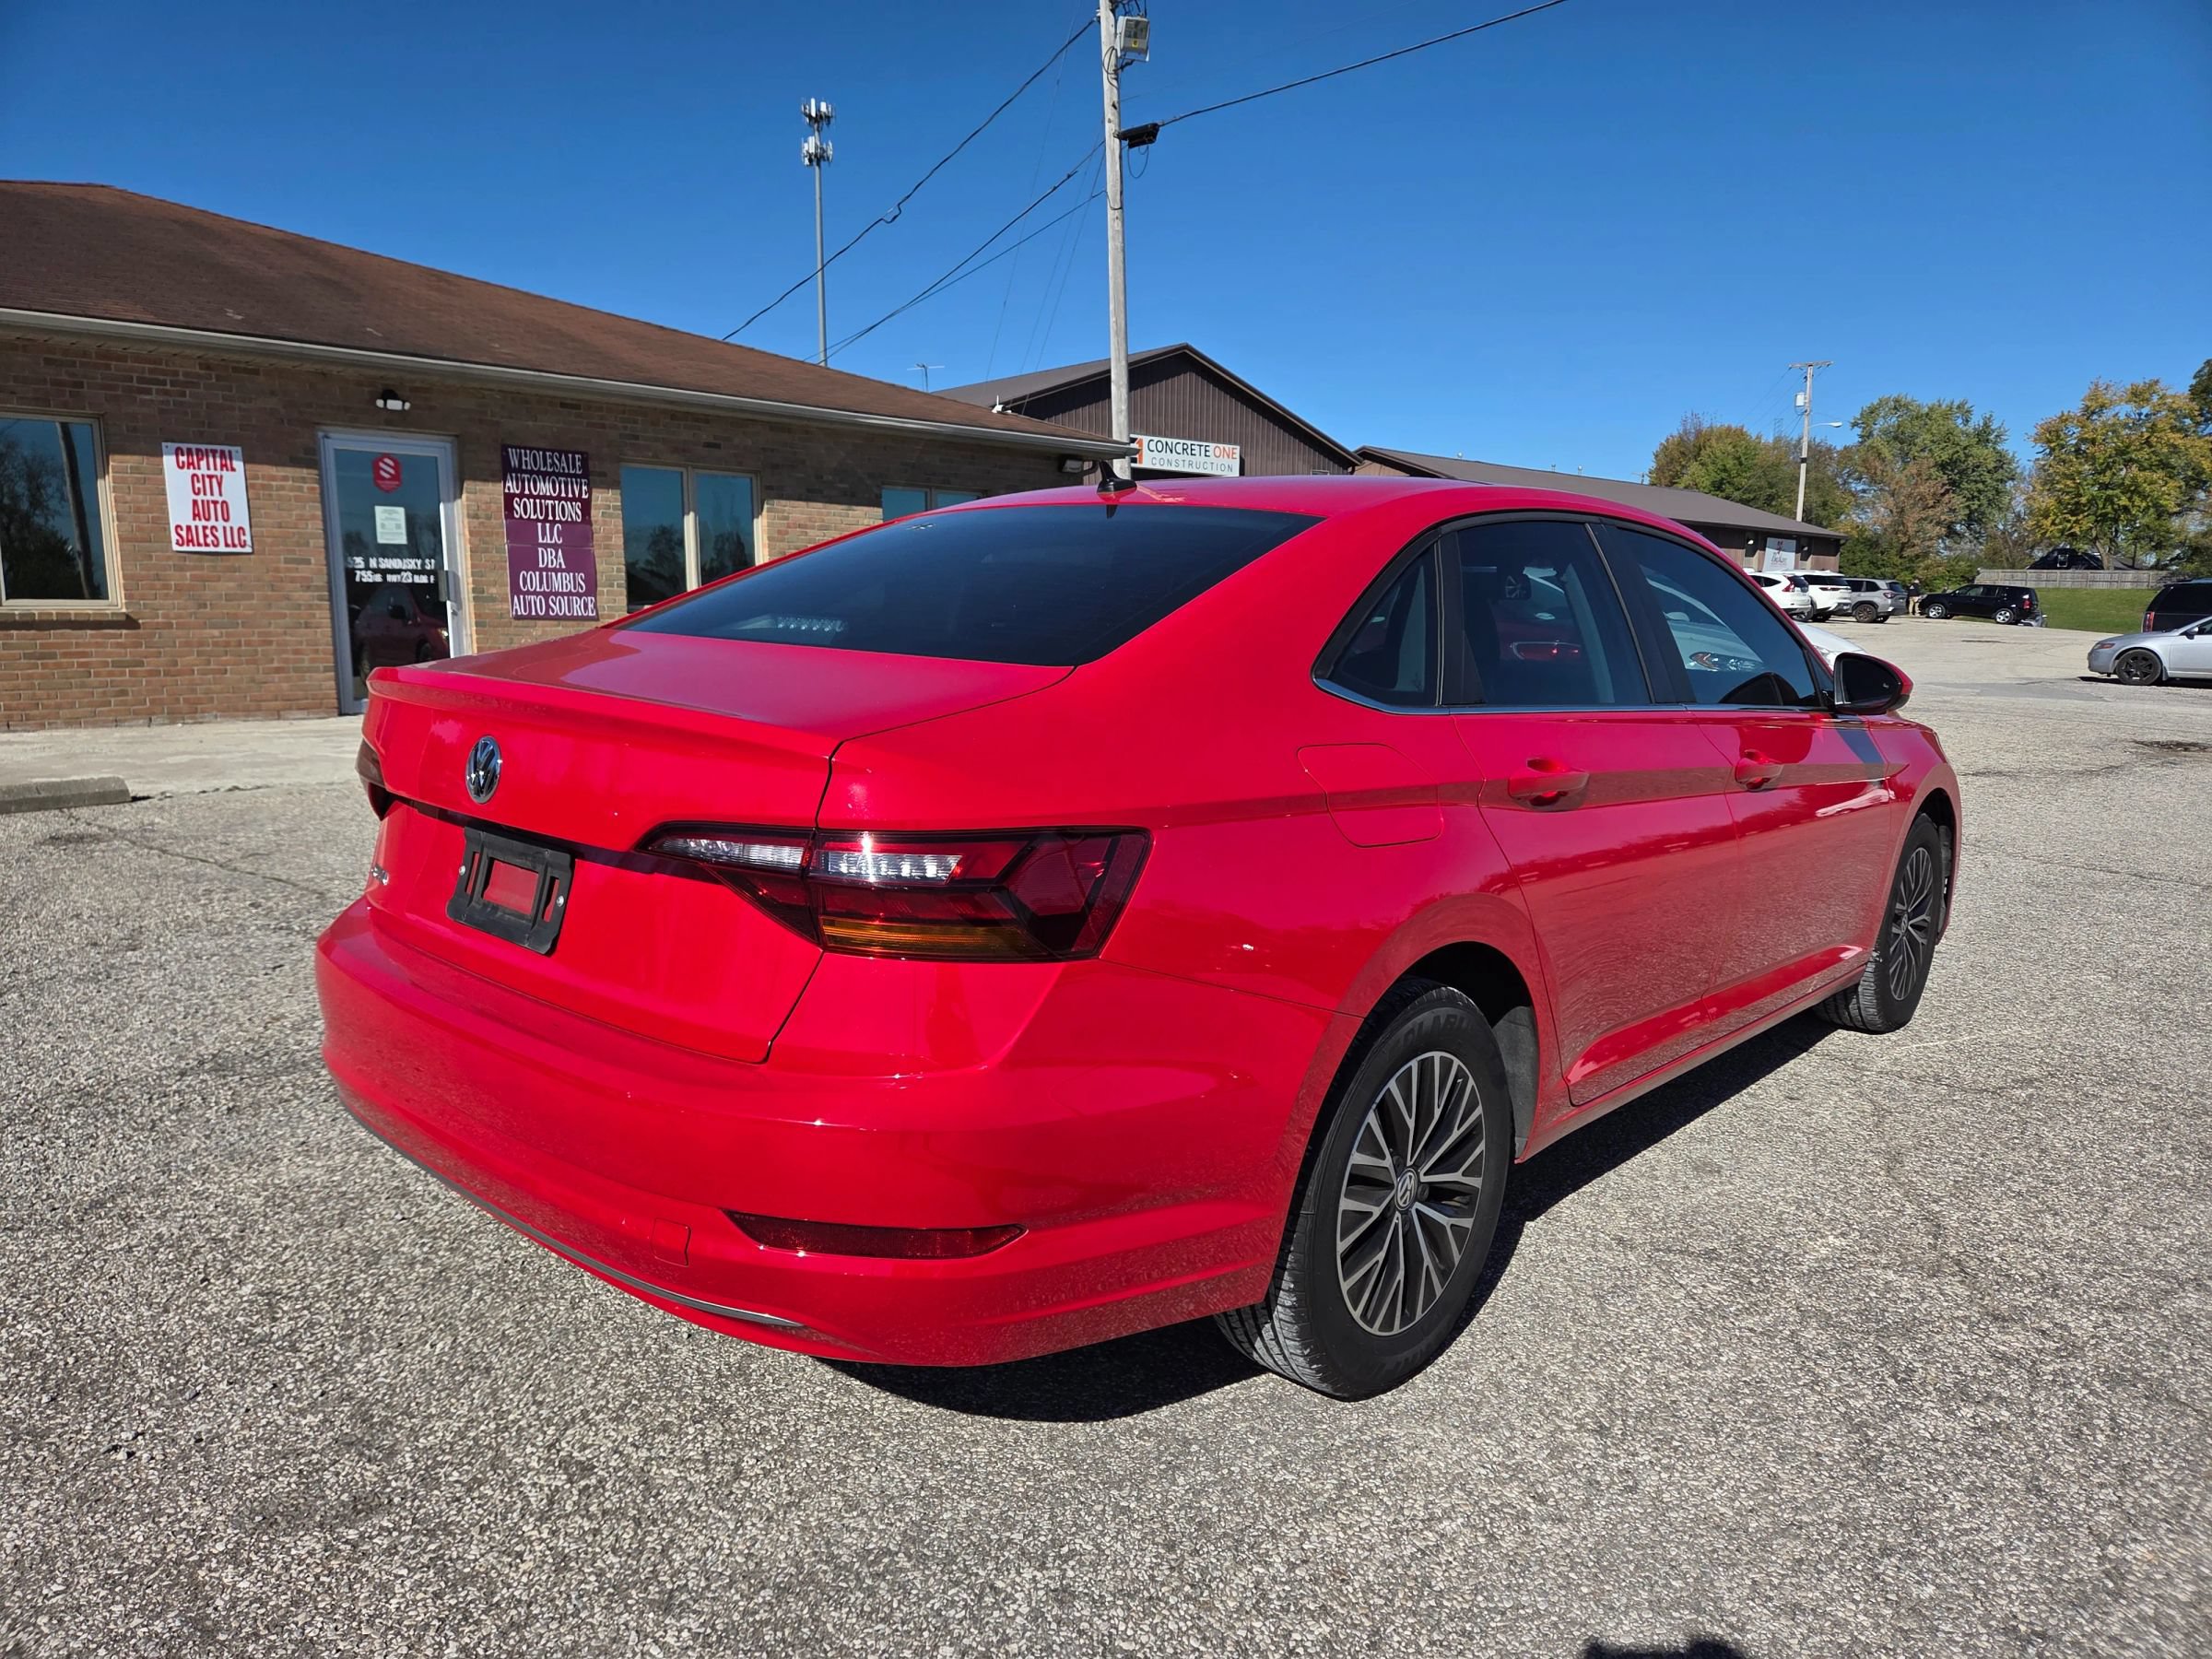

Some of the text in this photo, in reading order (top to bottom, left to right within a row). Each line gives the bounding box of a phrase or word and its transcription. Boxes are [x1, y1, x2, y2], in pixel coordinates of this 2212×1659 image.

[174, 446, 237, 473] CAPITAL
[508, 448, 582, 475] WHOLESALE
[1147, 439, 1238, 460] CONCRETE ONE
[1151, 456, 1233, 473] CONSTRUCTION
[191, 473, 223, 497] CITY
[504, 473, 589, 500] AUTOMOTIVE
[192, 499, 230, 523] AUTO
[512, 498, 582, 523] SOLUTIONS
[174, 524, 247, 548] SALES LLC
[536, 522, 563, 544] LLC
[537, 547, 566, 569] DBA
[519, 571, 586, 594] COLUMBUS
[512, 594, 596, 618] AUTO SOURCE
